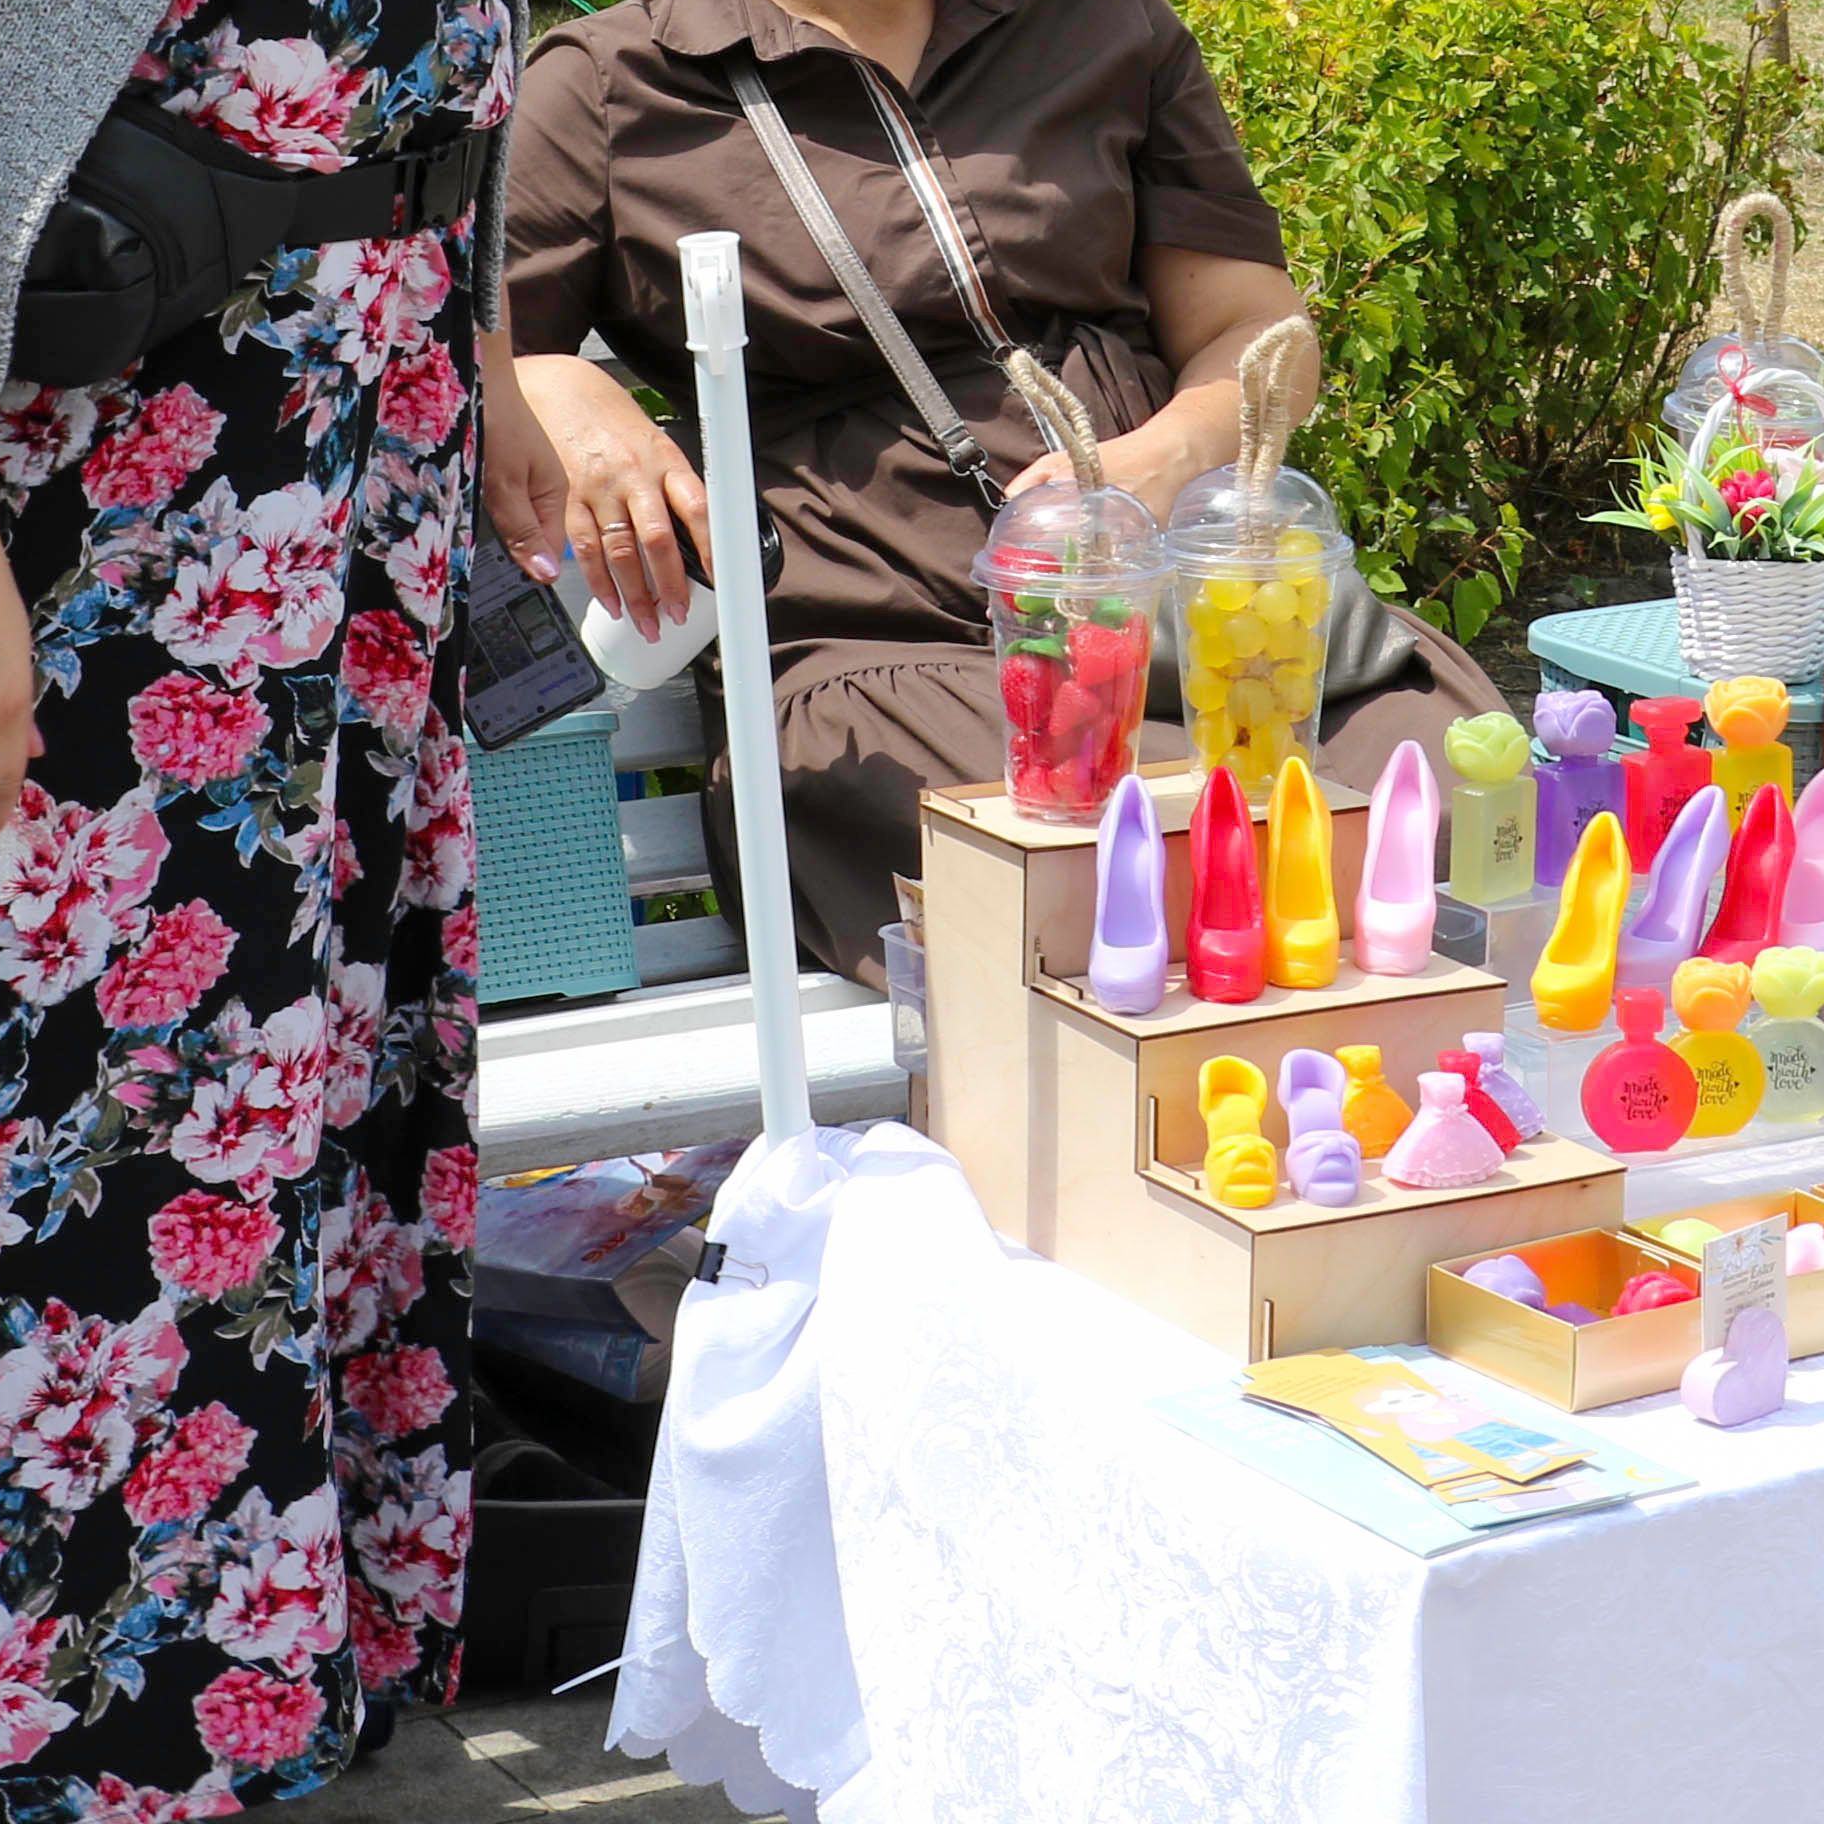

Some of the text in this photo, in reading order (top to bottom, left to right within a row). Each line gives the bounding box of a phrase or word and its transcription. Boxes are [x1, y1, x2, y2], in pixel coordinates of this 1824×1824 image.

[1769, 1045, 1808, 1065] made
[1771, 1076, 1804, 1090] love
[1775, 1062, 1812, 1084] with
